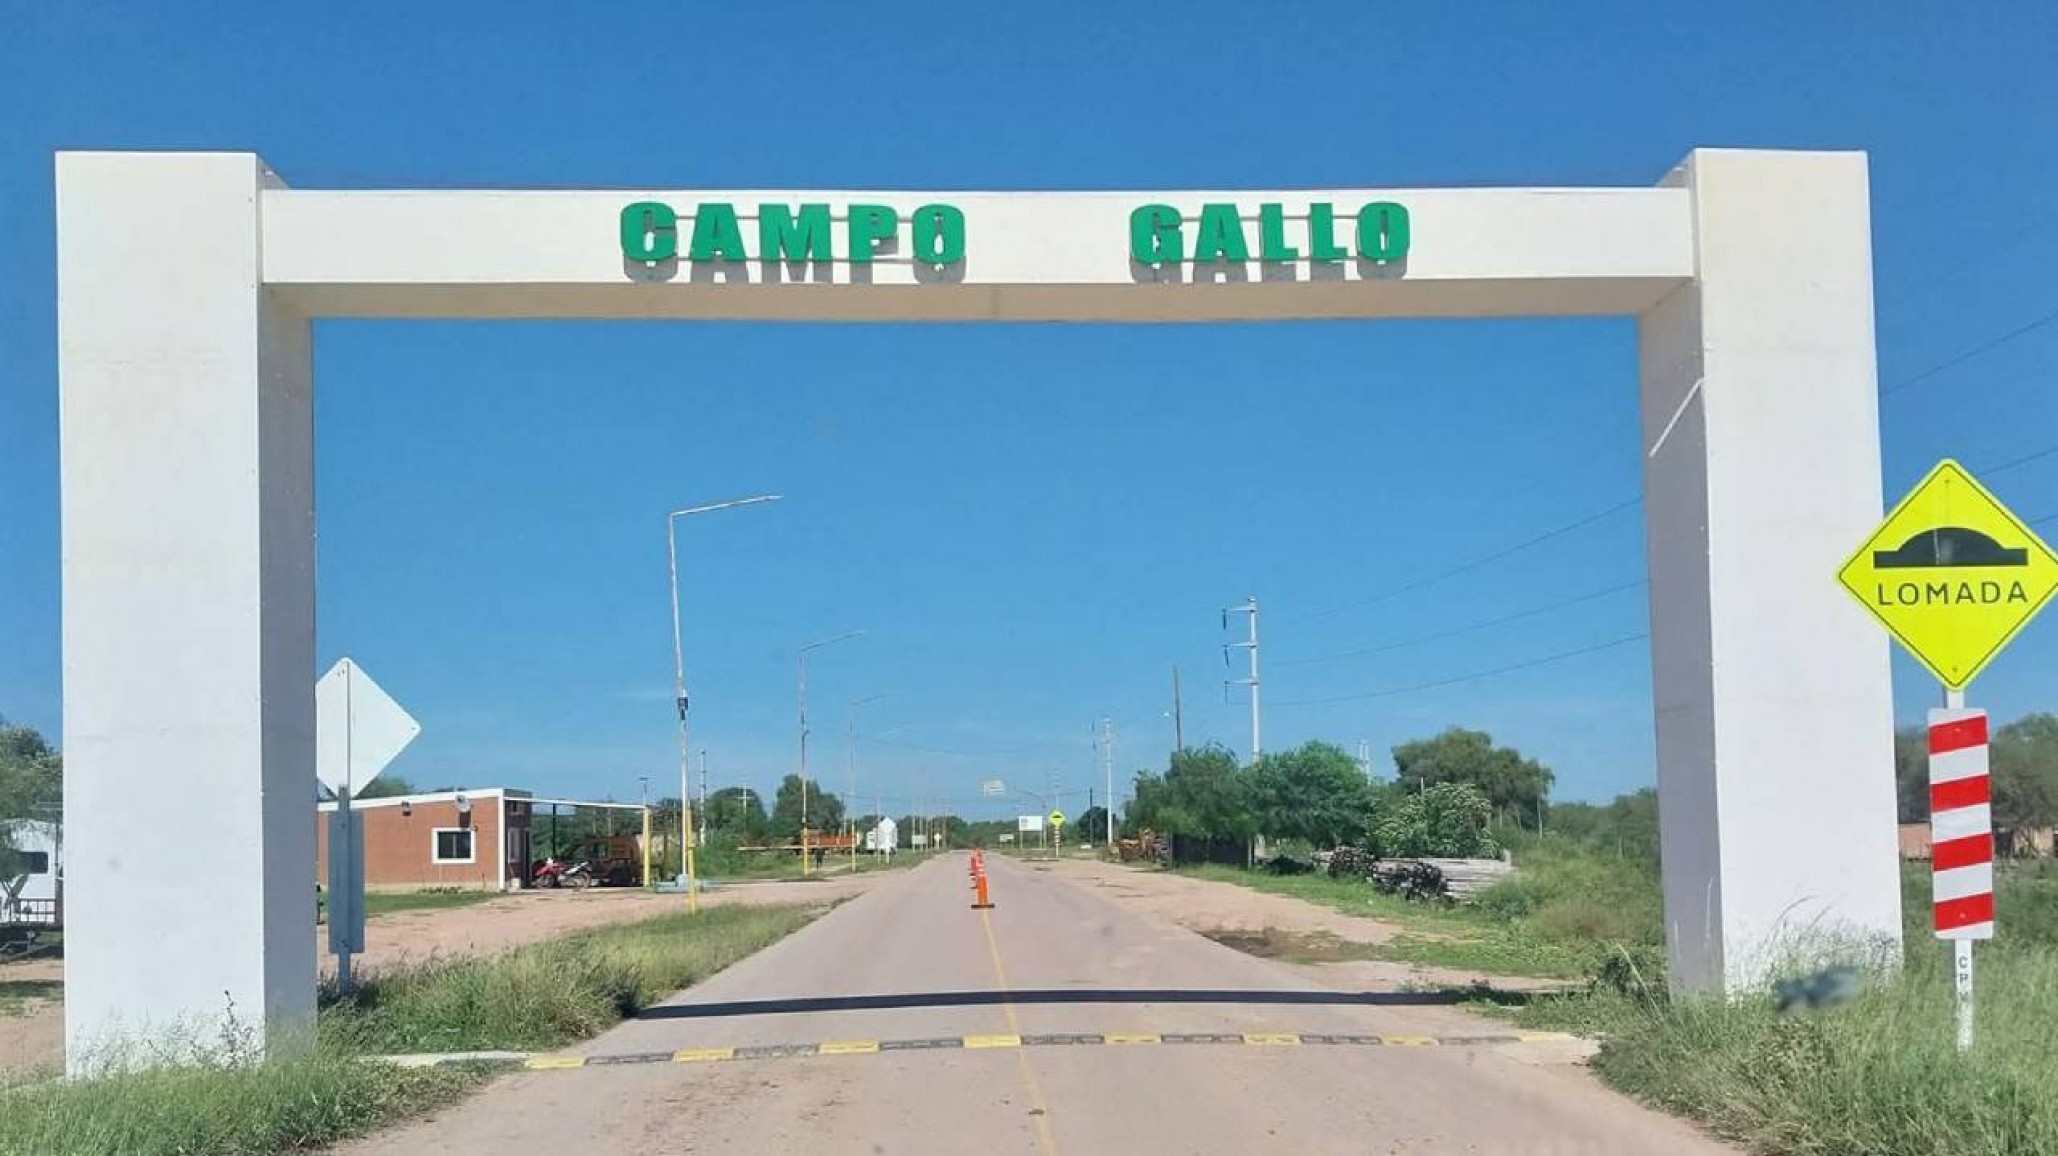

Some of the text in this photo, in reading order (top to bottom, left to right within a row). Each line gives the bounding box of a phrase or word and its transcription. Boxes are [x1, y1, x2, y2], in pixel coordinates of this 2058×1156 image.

[620, 201, 1410, 264] CAMPO GALLO
[1877, 580, 2029, 606] LOMADA
